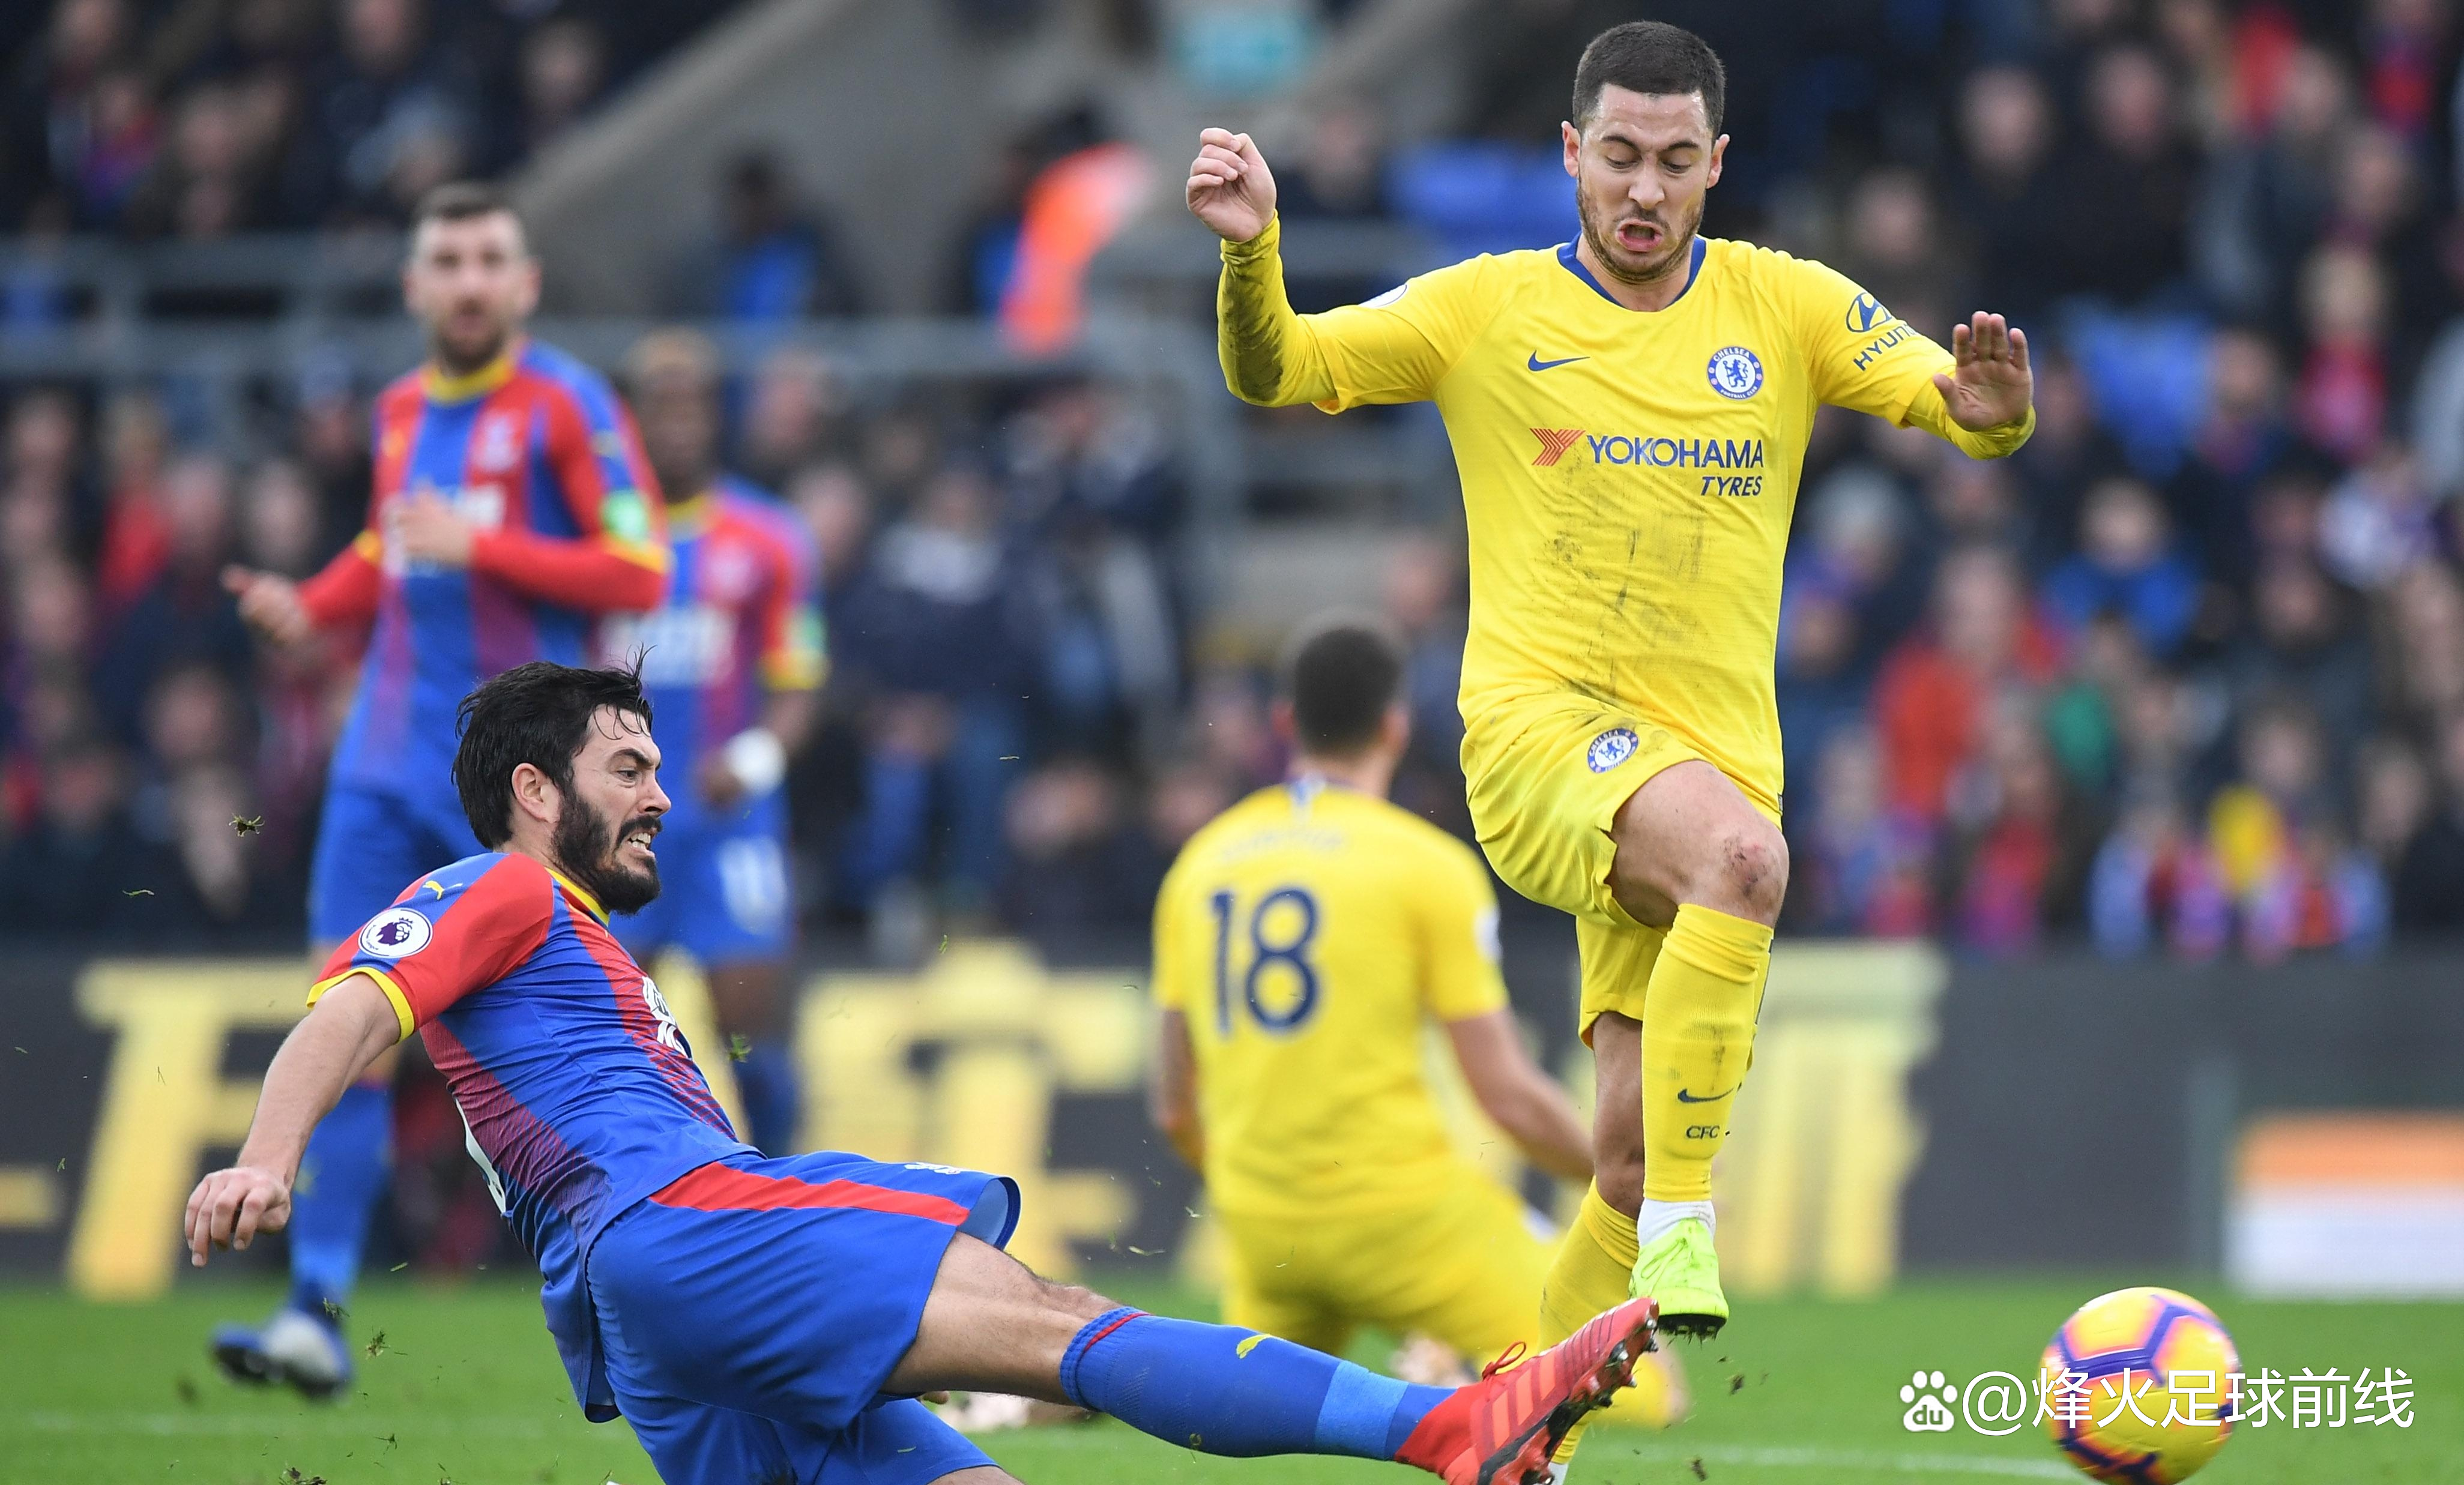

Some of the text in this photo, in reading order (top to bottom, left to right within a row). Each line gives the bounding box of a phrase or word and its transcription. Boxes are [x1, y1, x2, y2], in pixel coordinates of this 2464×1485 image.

[1713, 348, 1750, 362] CHELSEA
[1587, 435, 1764, 468] YOKOHAMA
[1701, 475, 1763, 496] TYRES
[1210, 888, 1318, 1034] 18
[1685, 1125, 1720, 1139] CFC
